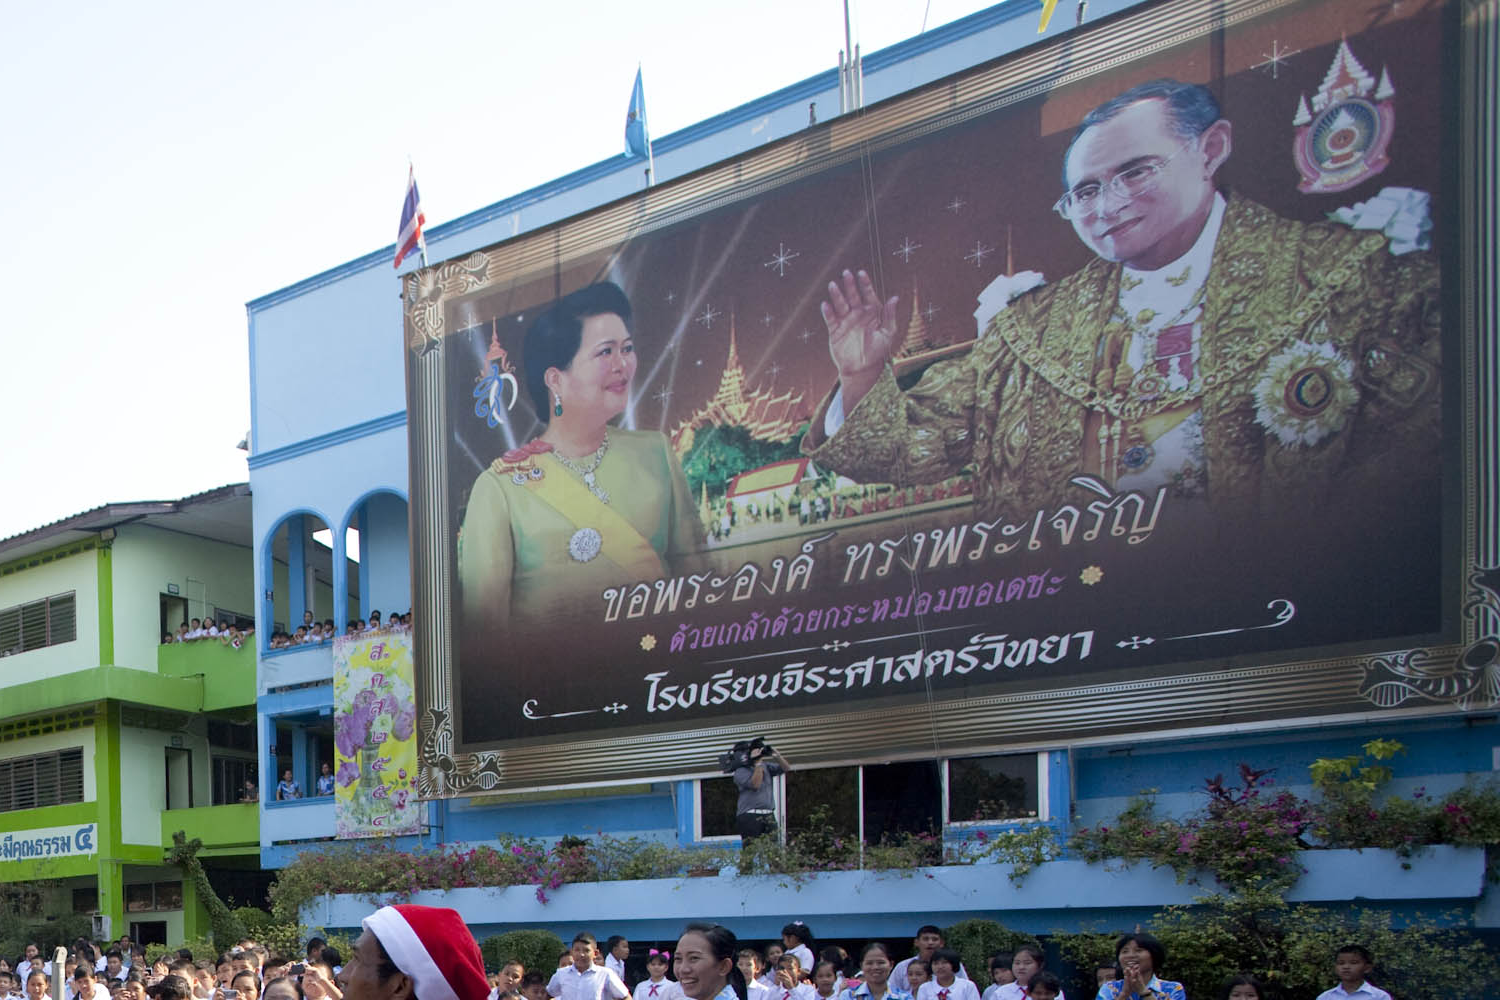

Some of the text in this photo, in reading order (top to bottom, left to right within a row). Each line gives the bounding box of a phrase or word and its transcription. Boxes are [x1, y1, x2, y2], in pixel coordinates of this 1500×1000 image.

[602, 476, 1167, 623] ขอพระองค์ ทรงพระเจริญ
[643, 629, 1095, 713] โรงเรียนจิระศาสตร์วิทยา
